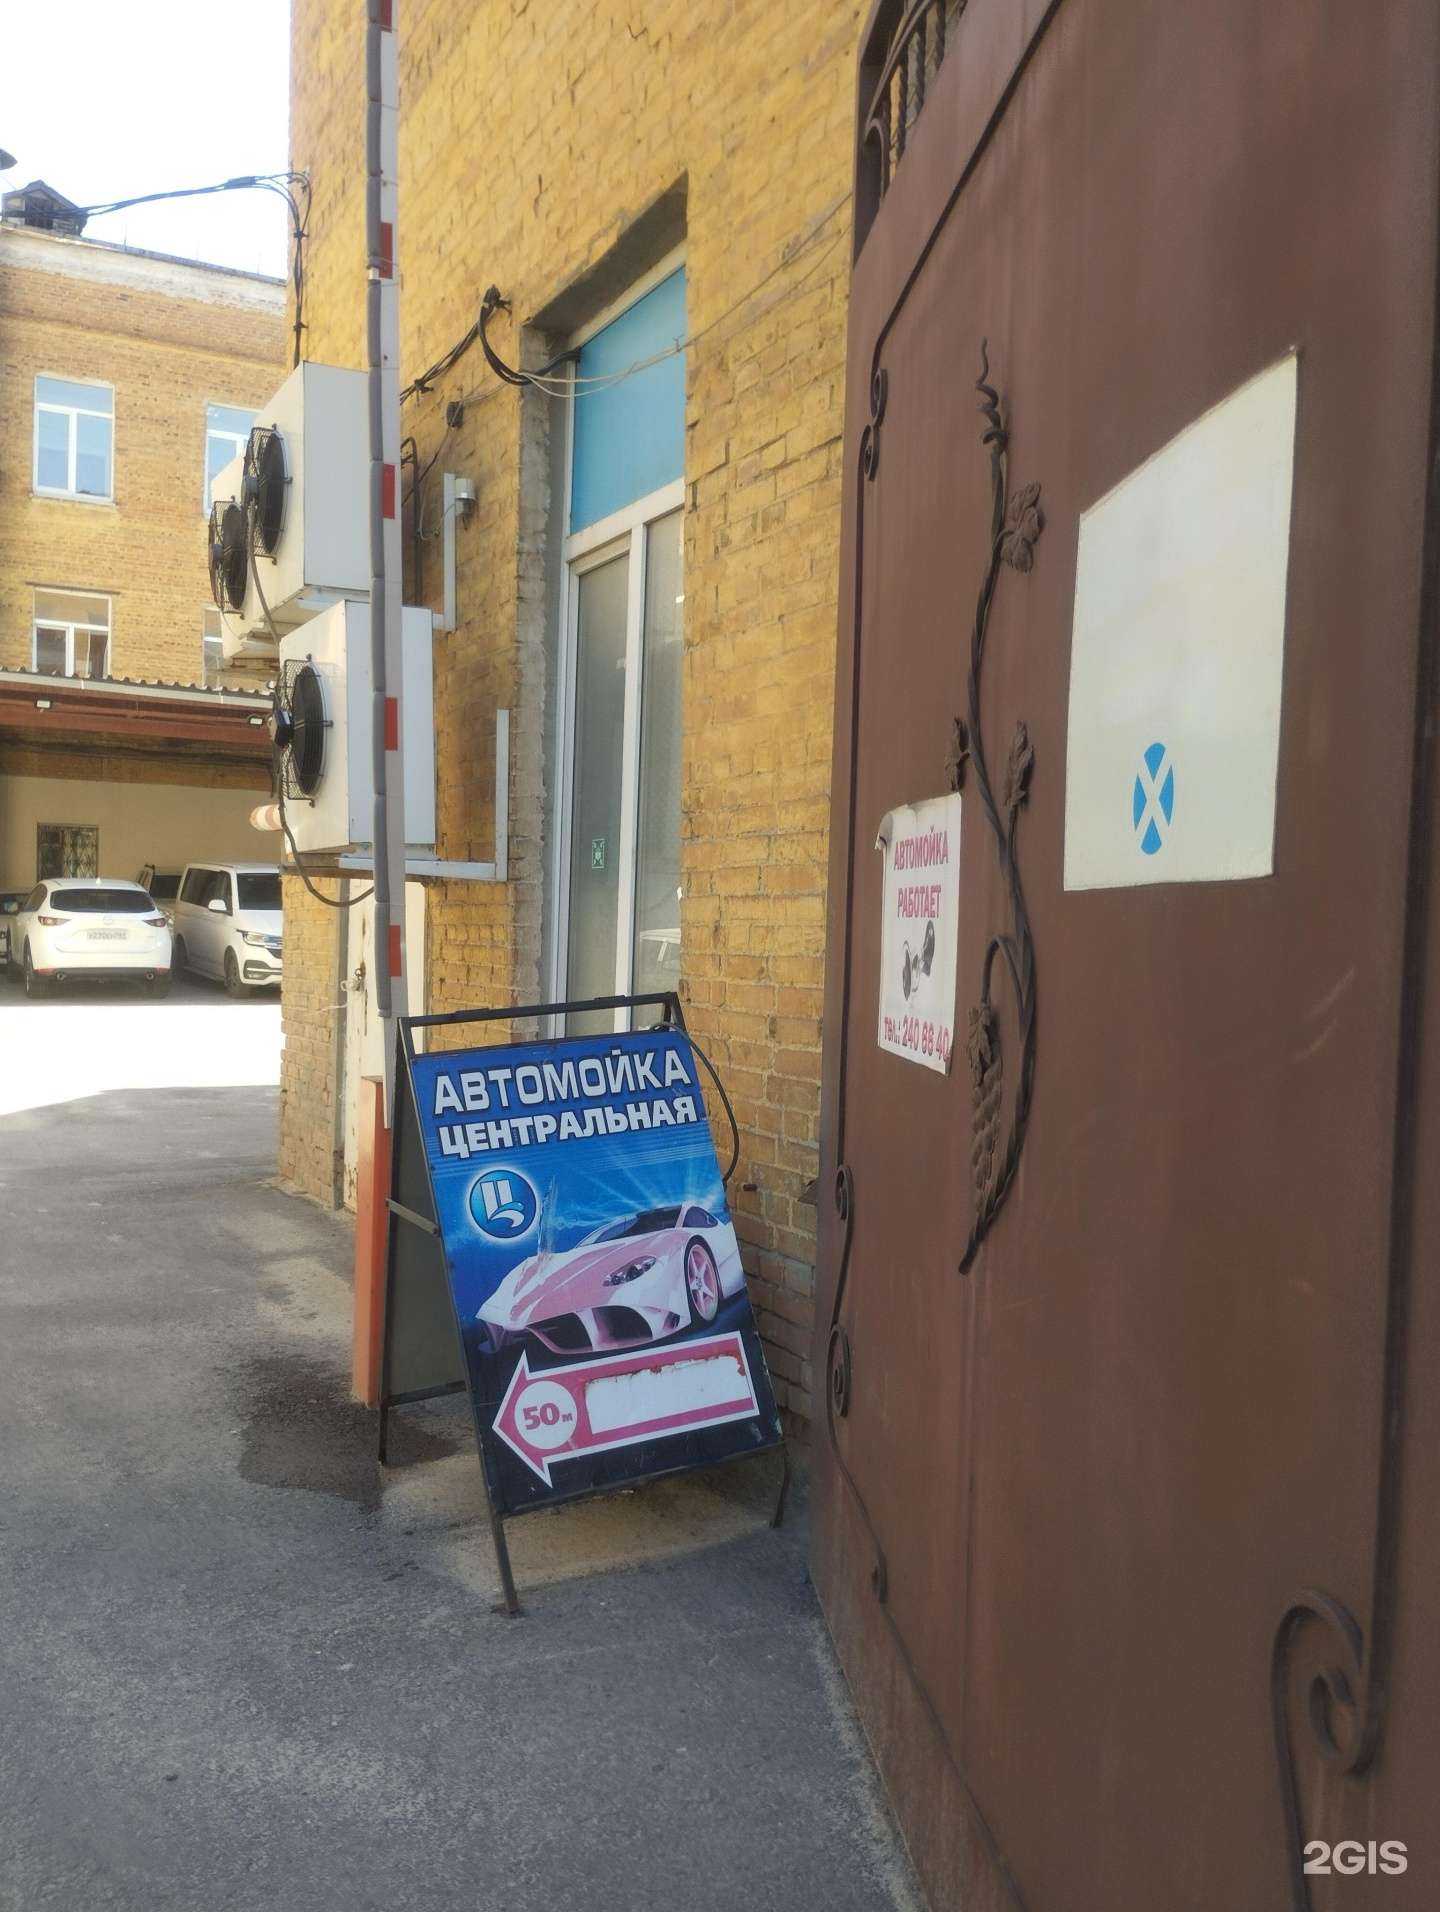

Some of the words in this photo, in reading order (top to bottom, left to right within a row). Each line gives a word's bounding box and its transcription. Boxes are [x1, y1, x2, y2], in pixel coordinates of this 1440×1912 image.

[893, 825, 949, 870] АВТОМОЙКА
[897, 885, 941, 918] РАБОТАЕТ
[902, 1014, 919, 1050] 240
[936, 1025, 951, 1062] 40
[433, 1048, 692, 1115] АВТОМОЙКА
[438, 1095, 698, 1160] ЦЕНТРАЛЬНАЯ
